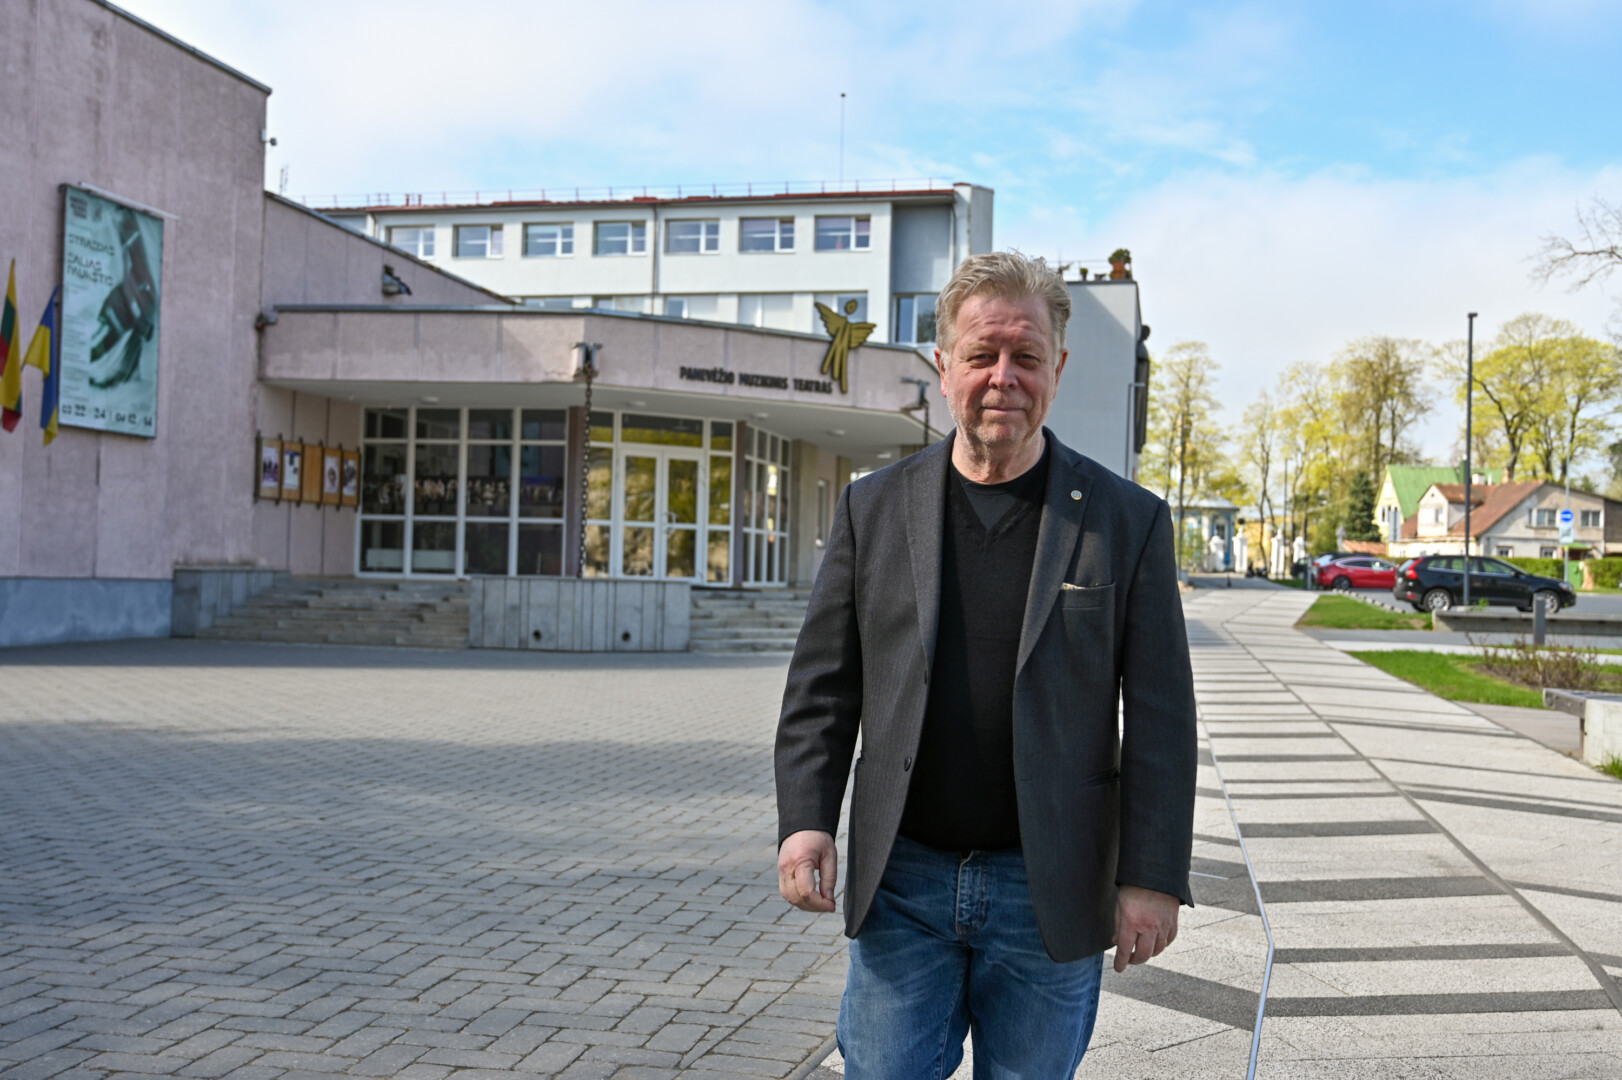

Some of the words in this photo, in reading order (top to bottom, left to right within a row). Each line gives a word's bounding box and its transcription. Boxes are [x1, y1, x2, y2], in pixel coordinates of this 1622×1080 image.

[680, 366, 735, 385] PANEVĖŽIO
[738, 373, 788, 390] MUZIKINIS
[793, 378, 833, 394] TEATRAS
